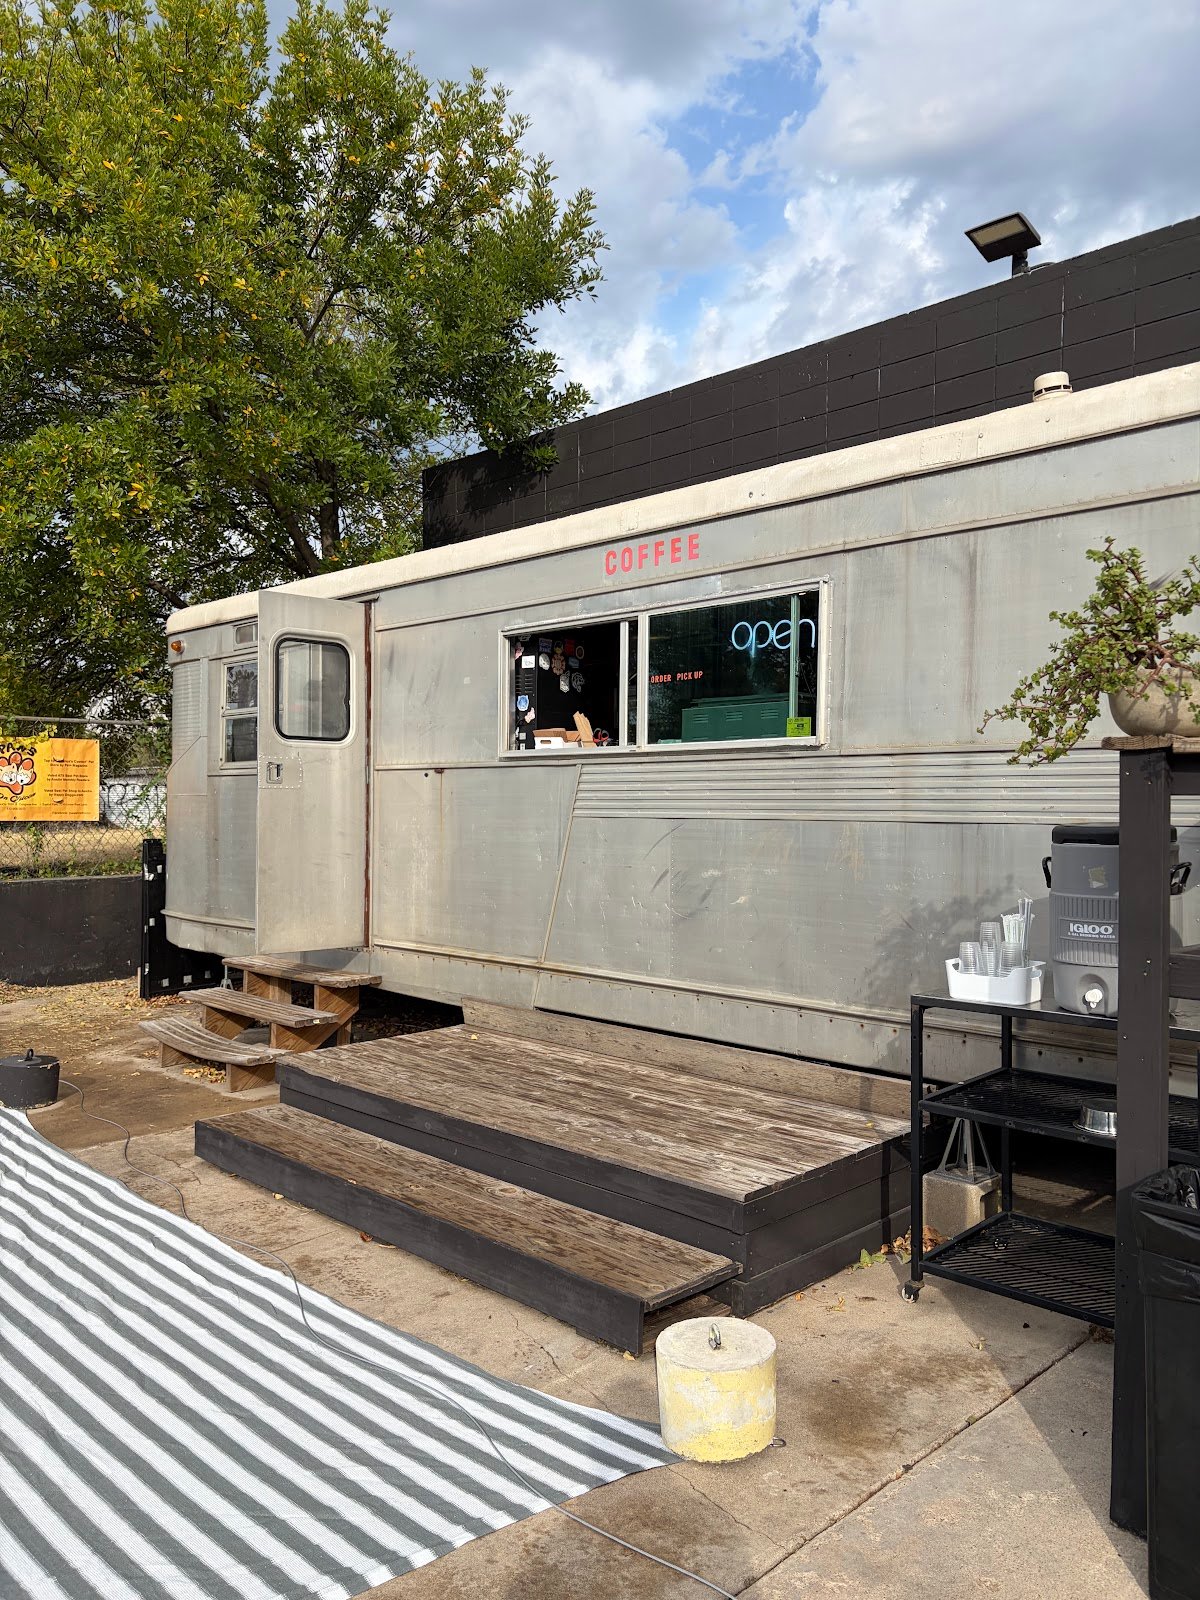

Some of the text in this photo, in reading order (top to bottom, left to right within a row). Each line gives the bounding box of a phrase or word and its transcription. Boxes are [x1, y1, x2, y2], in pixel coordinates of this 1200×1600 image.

[605, 533, 700, 576] COFFEE
[732, 618, 816, 658] open
[650, 670, 703, 684] ORDER PICK UP
[1069, 922, 1113, 934] IGLOO
